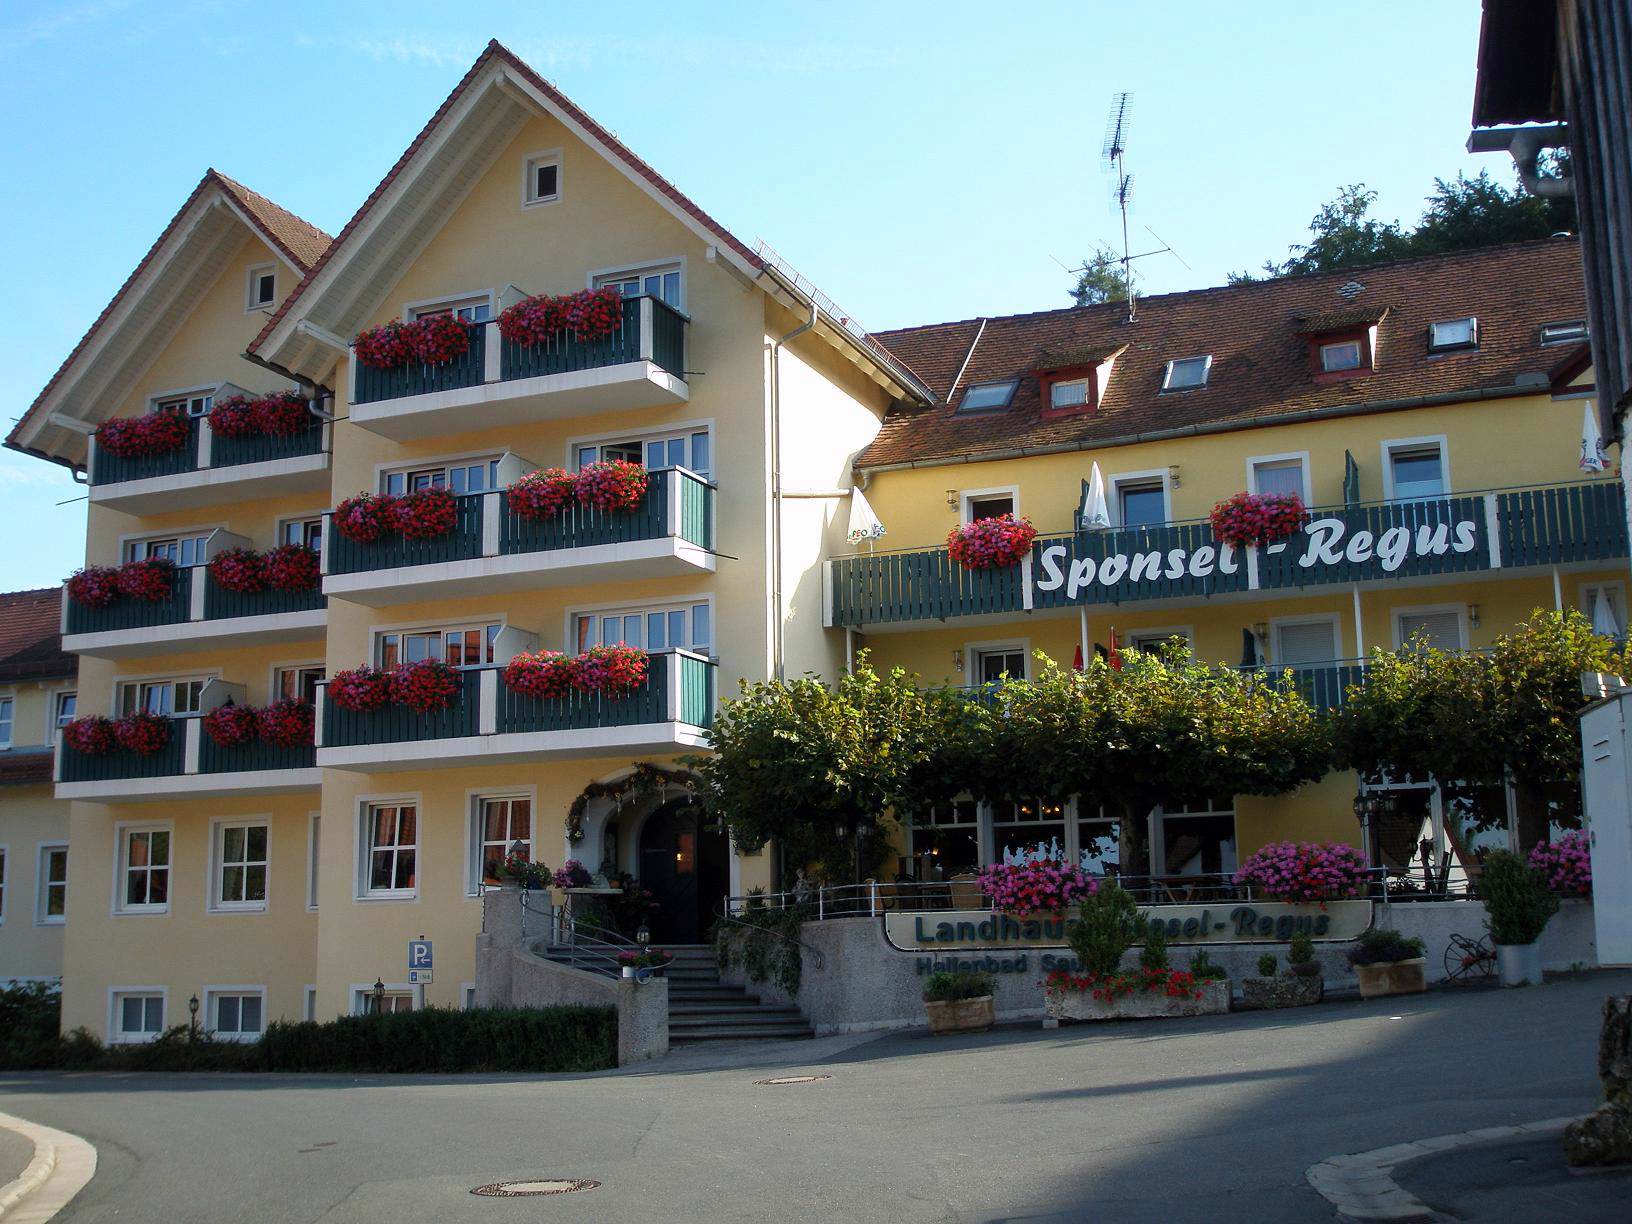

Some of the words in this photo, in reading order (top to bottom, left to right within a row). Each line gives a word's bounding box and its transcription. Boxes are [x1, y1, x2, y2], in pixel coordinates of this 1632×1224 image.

[1037, 545, 1239, 600] Sponsel
[1298, 518, 1476, 572] Regus
[414, 944, 428, 965] P
[1040, 953, 1086, 974] Sau
